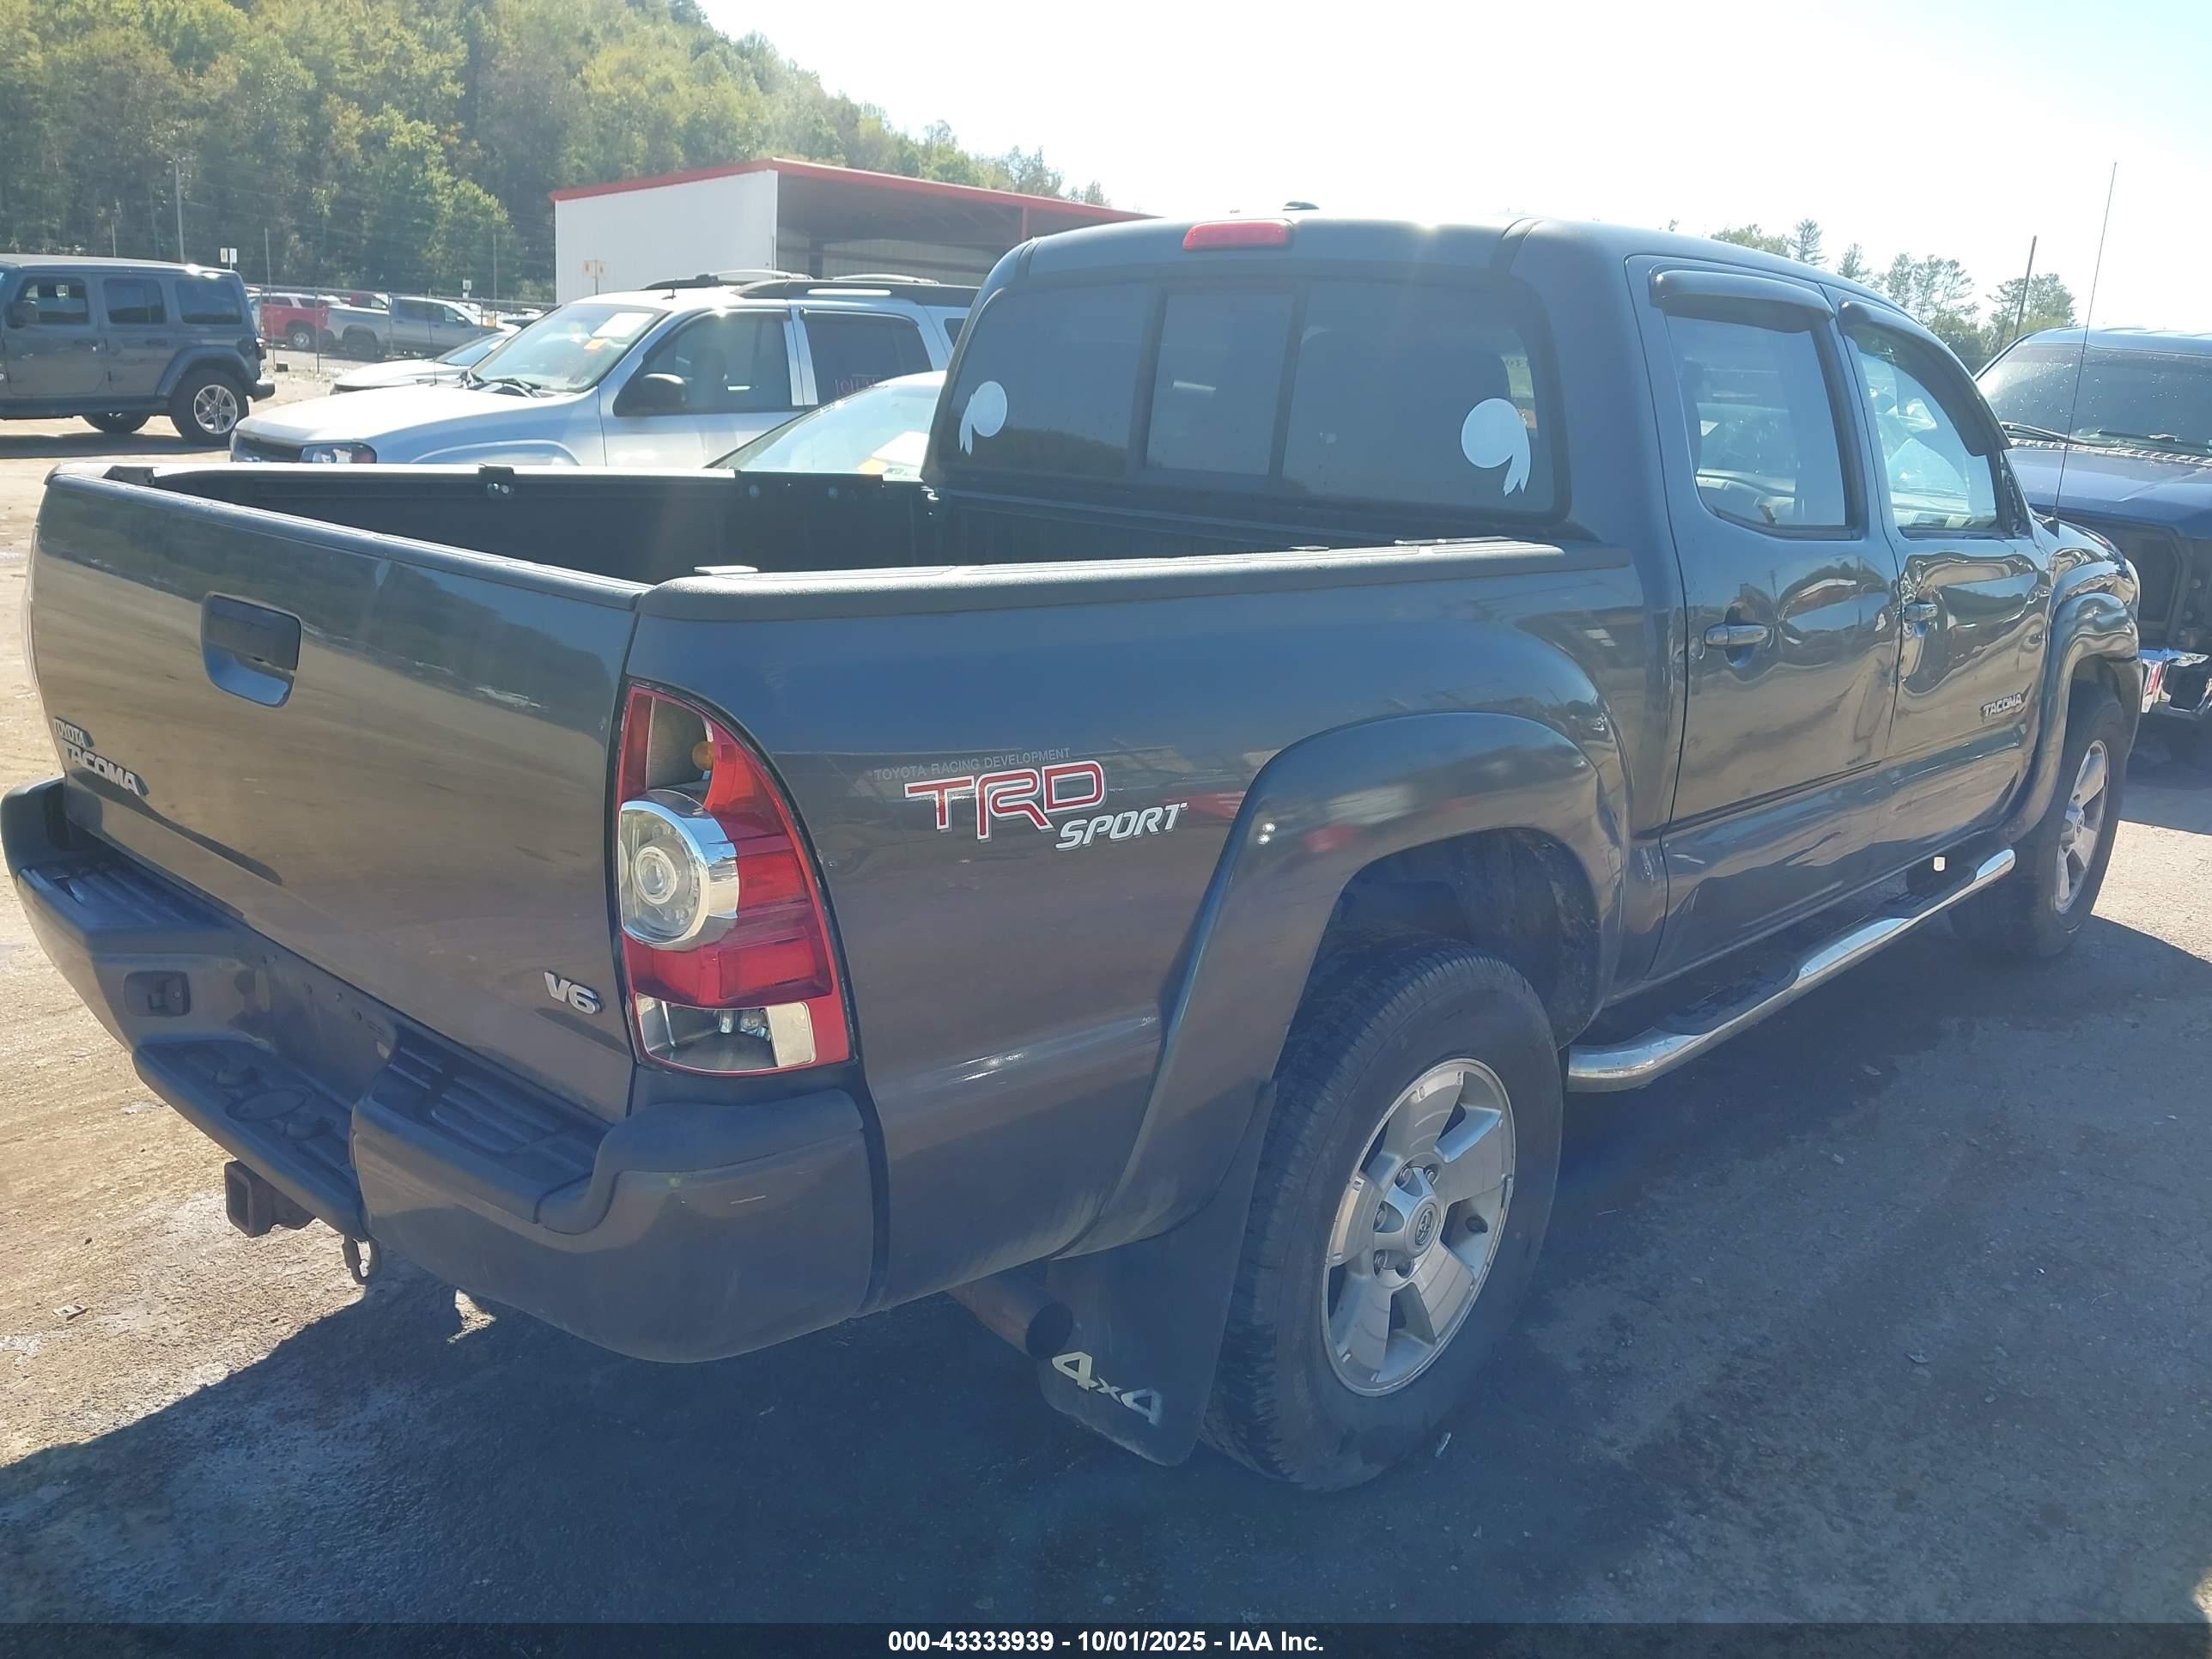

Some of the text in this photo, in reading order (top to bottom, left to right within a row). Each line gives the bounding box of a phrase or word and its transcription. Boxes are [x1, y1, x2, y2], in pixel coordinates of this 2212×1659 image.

[1983, 694, 2022, 717] TACOMA
[53, 719, 86, 748] TOYOTA
[64, 739, 140, 796] TACOMA
[874, 747, 1072, 781] TOYOTA RACING DEVELOPMENT
[904, 760, 1106, 840] TRD
[1055, 802, 1188, 850] SPORT
[544, 971, 600, 1014] V6
